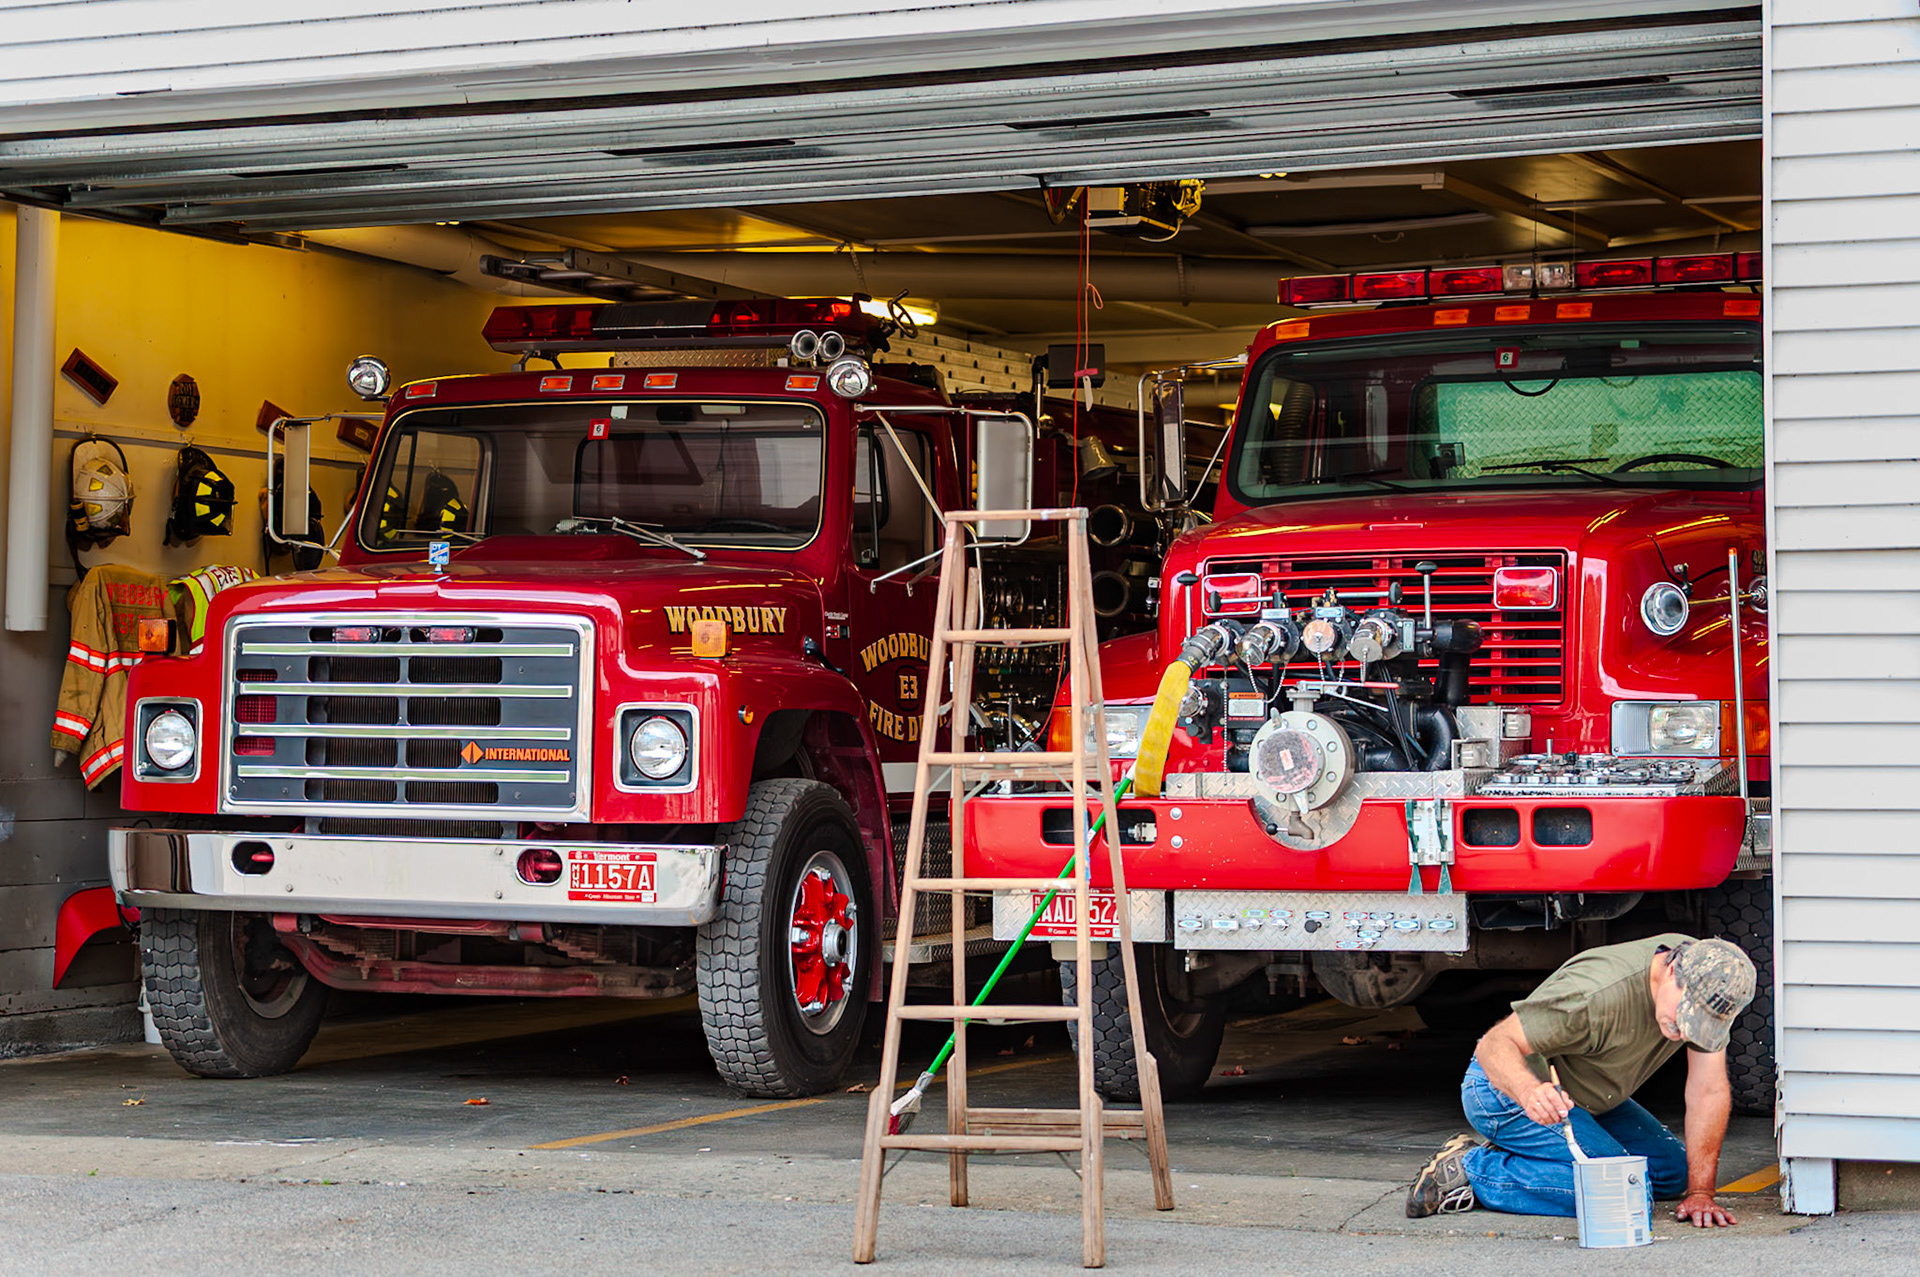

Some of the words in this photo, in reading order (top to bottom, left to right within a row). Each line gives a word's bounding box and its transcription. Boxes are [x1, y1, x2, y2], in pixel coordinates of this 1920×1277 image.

[860, 632, 933, 673] WOODBU
[899, 675, 918, 699] E3
[869, 699, 905, 741] FIRE
[485, 747, 571, 762] INTERNATIONAL
[593, 851, 631, 861] Vermont
[571, 863, 580, 888] MUN
[580, 864, 651, 890] 1157A
[1706, 992, 1736, 1016] FIRE
